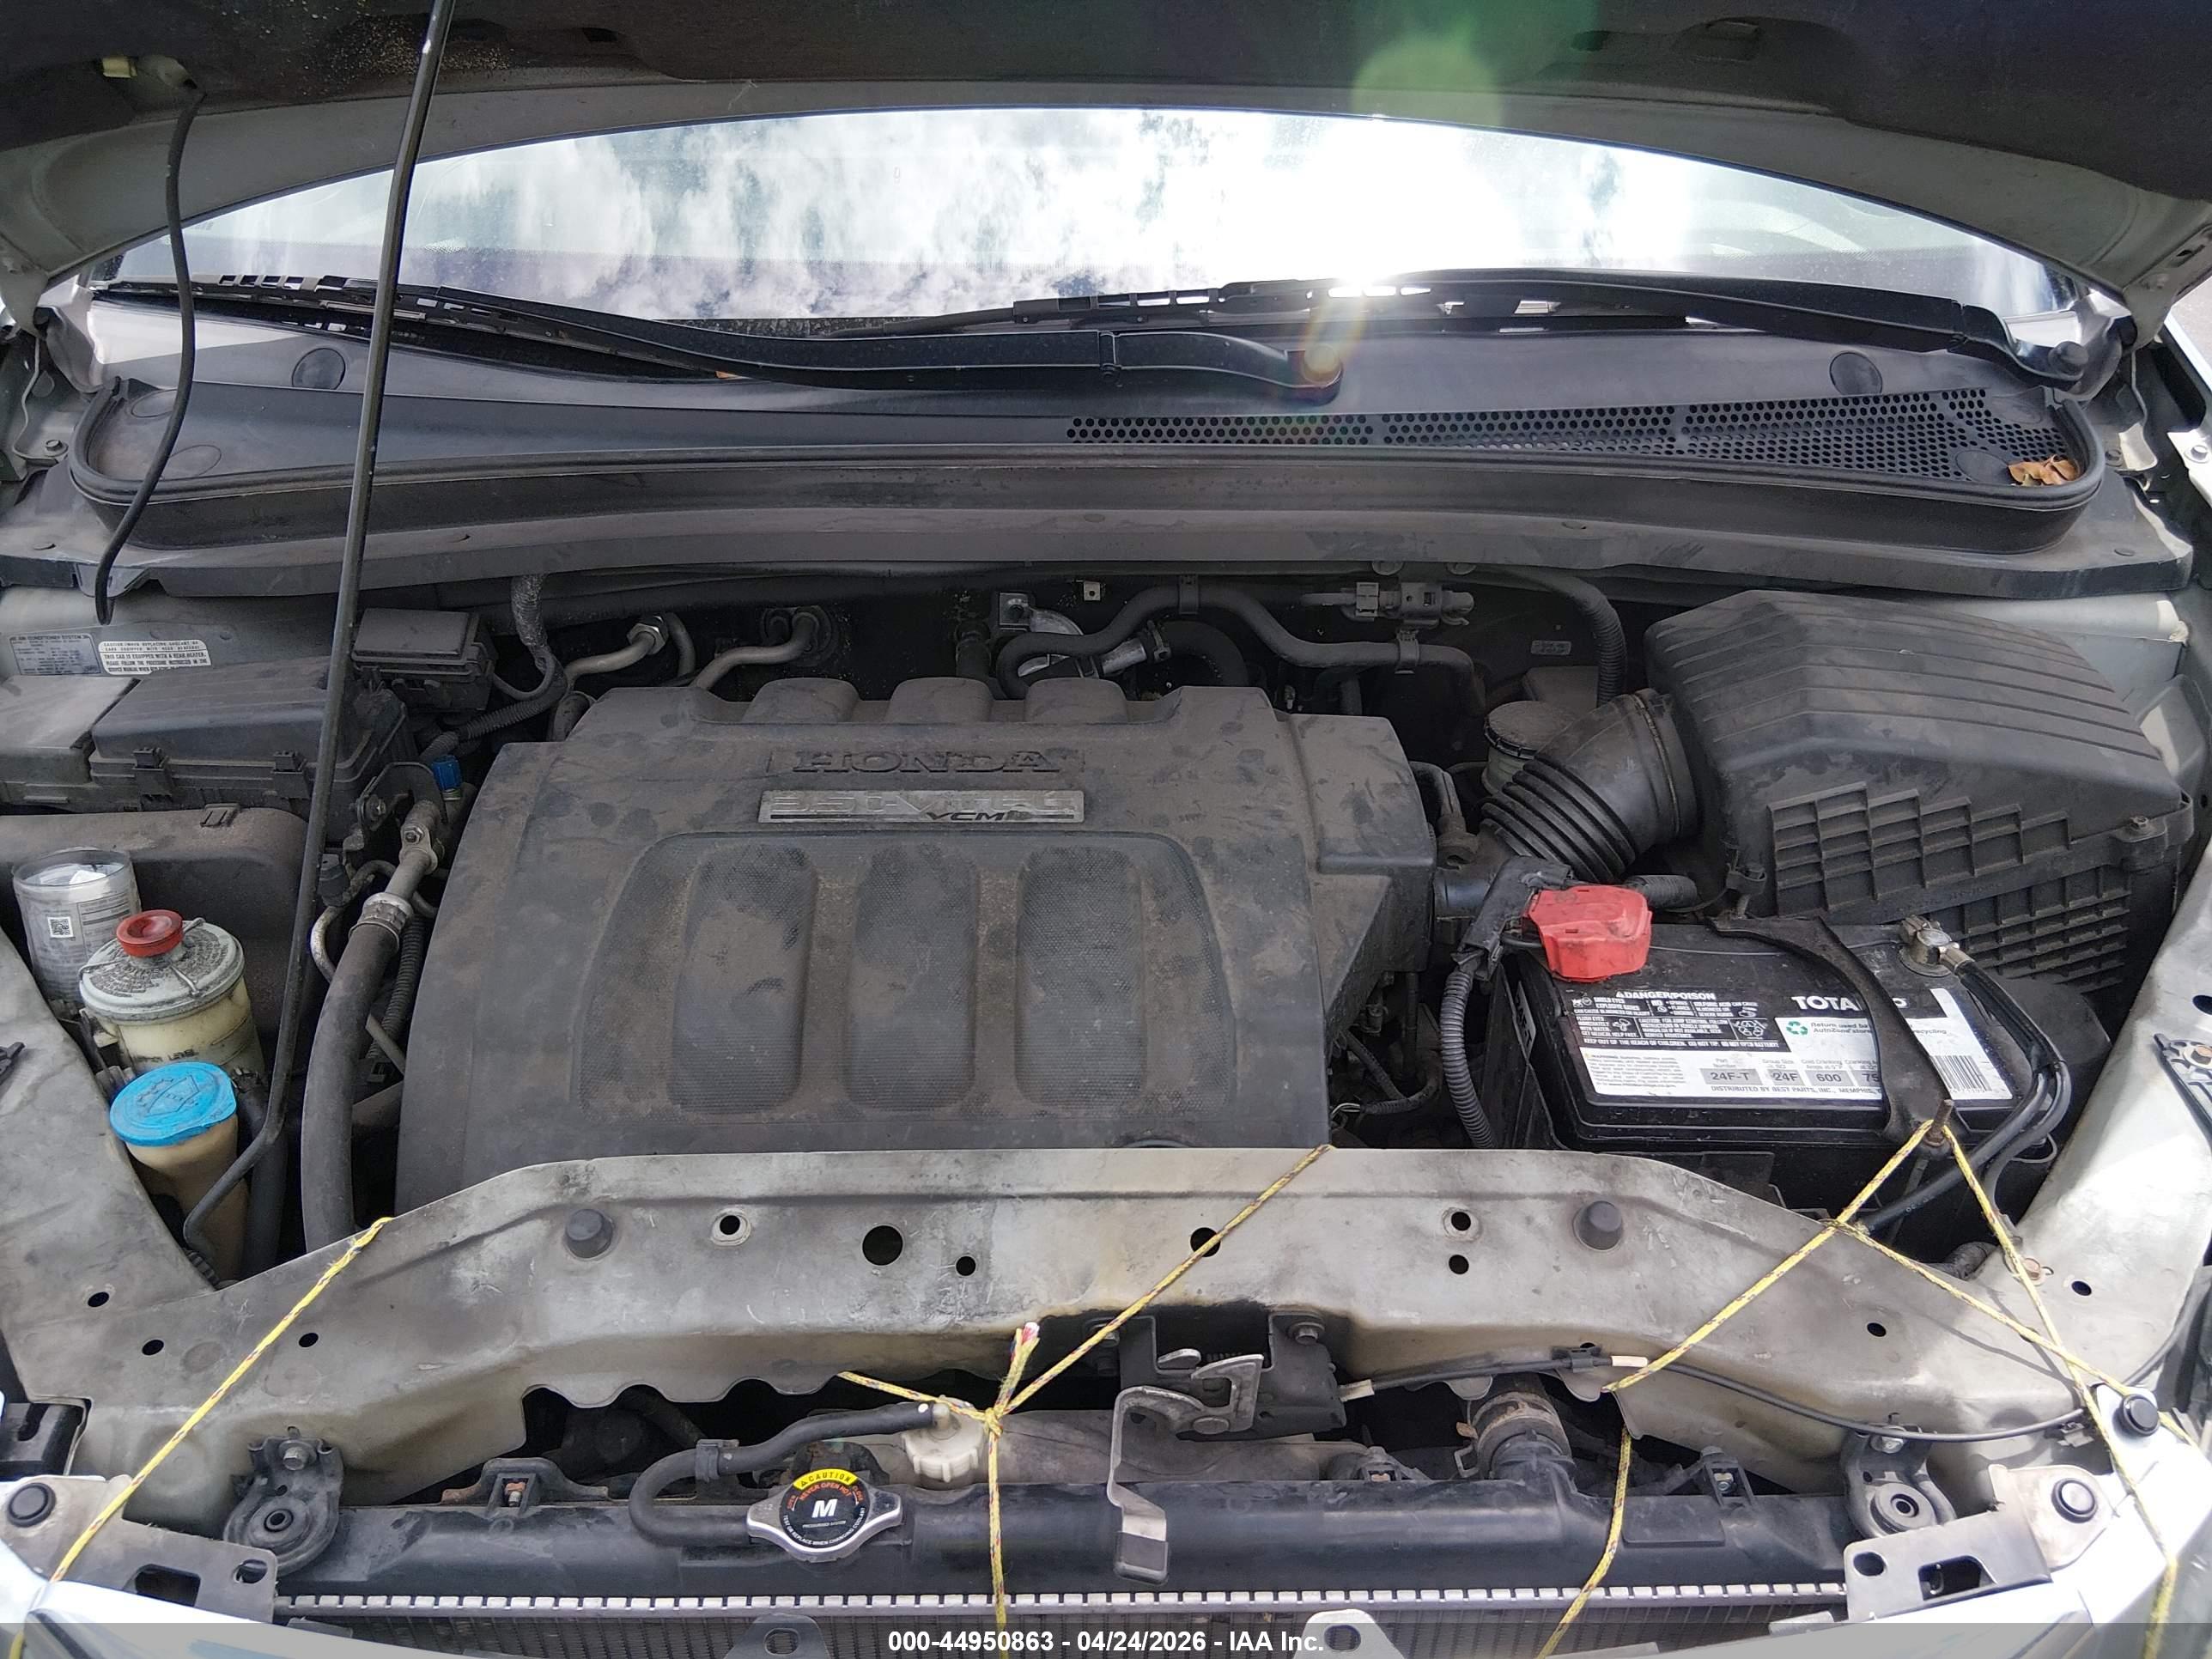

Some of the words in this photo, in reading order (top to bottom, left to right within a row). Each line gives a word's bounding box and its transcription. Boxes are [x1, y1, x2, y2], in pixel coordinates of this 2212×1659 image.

[792, 750, 1061, 774] HONDA
[926, 811, 1006, 822] VCM
[1624, 991, 1717, 1001] DANGER/POISON
[1791, 995, 1863, 1012] TOTA
[1710, 1072, 1750, 1081] 24F-T
[1772, 1073, 1799, 1082] 24F
[1815, 1073, 1843, 1083] 600
[1862, 1073, 1881, 1082] 75
[809, 1471, 853, 1483] CAUTION
[799, 1484, 821, 1501] NEVER
[839, 1485, 853, 1498] HOT
[811, 1498, 839, 1518] M
[792, 1530, 812, 1545] REPLACE
[829, 1528, 854, 1544] CHANGING
[852, 1507, 866, 1528] COOLANT
